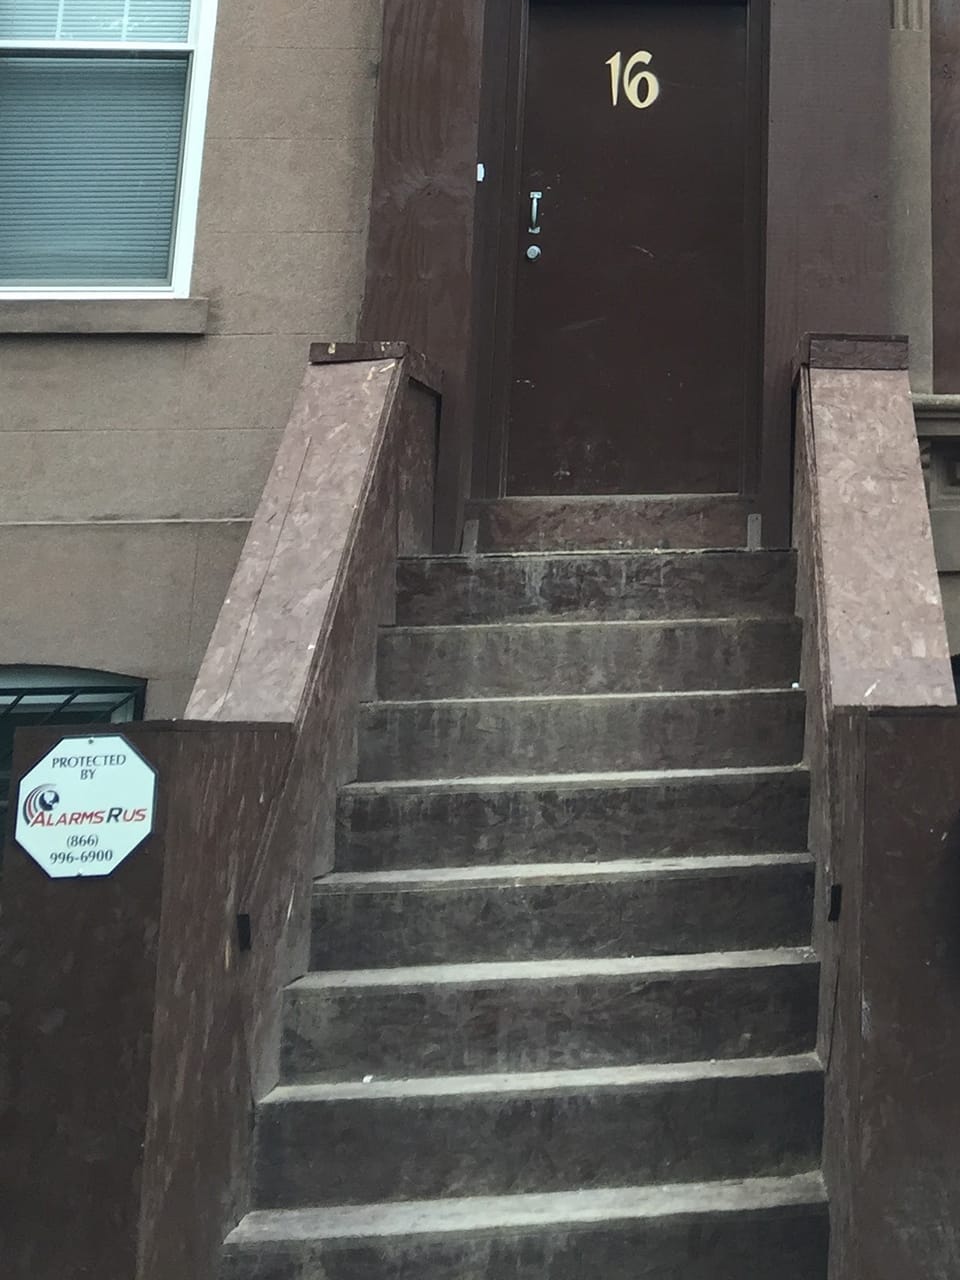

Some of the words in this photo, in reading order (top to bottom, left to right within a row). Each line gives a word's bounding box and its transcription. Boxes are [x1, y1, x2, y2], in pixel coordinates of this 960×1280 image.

[605, 50, 660, 109] 16
[51, 754, 126, 769] PROTECTED
[80, 768, 96, 780] BY
[66, 834, 99, 849] (866)
[50, 849, 113, 865] 996-6900
